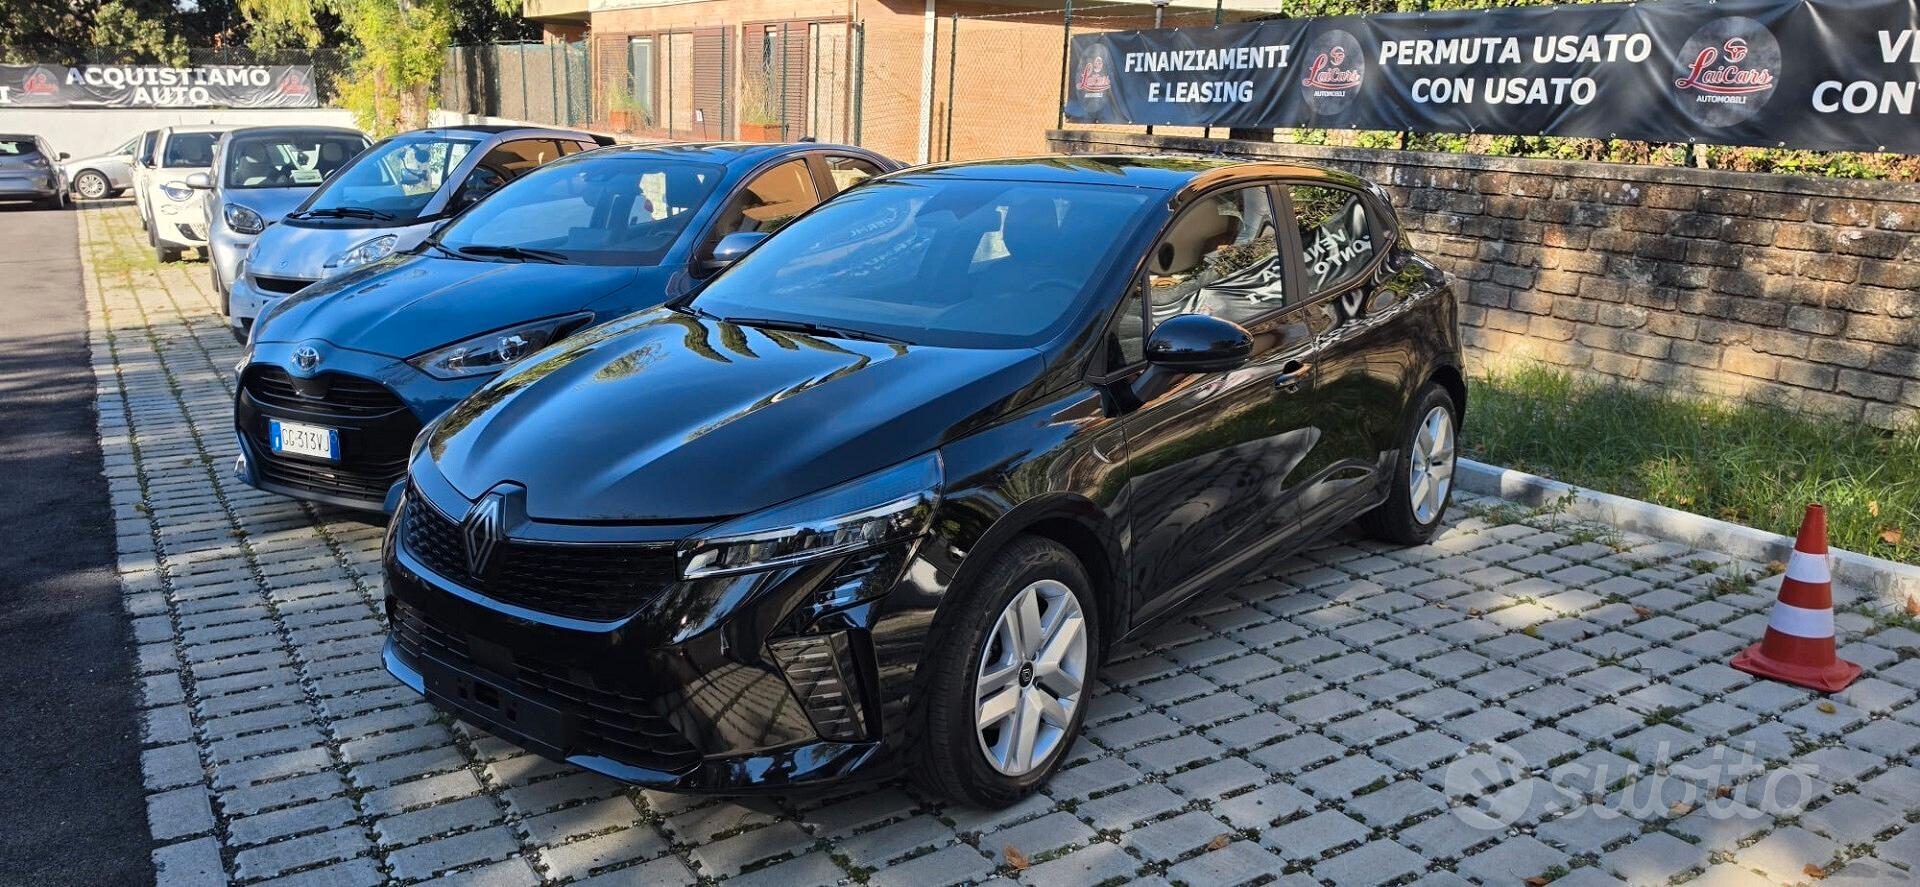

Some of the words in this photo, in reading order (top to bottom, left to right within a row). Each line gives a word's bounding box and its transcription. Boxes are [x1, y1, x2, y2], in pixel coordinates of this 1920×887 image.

[1125, 45, 1290, 73] FINANZIAMENTI
[1379, 36, 1521, 65] PERMUTA
[1532, 32, 1652, 64] USATO
[65, 67, 271, 89] ACQUISTIAMO
[1675, 46, 1773, 94] LaiCars
[132, 87, 209, 105] AUTO
[1148, 83, 1159, 103] E
[1165, 80, 1253, 104] LEASING
[1411, 78, 1474, 104] CON
[1484, 77, 1597, 106] USATO
[1696, 95, 1747, 104] AUTOMOBILI
[1812, 80, 1920, 115] CON
